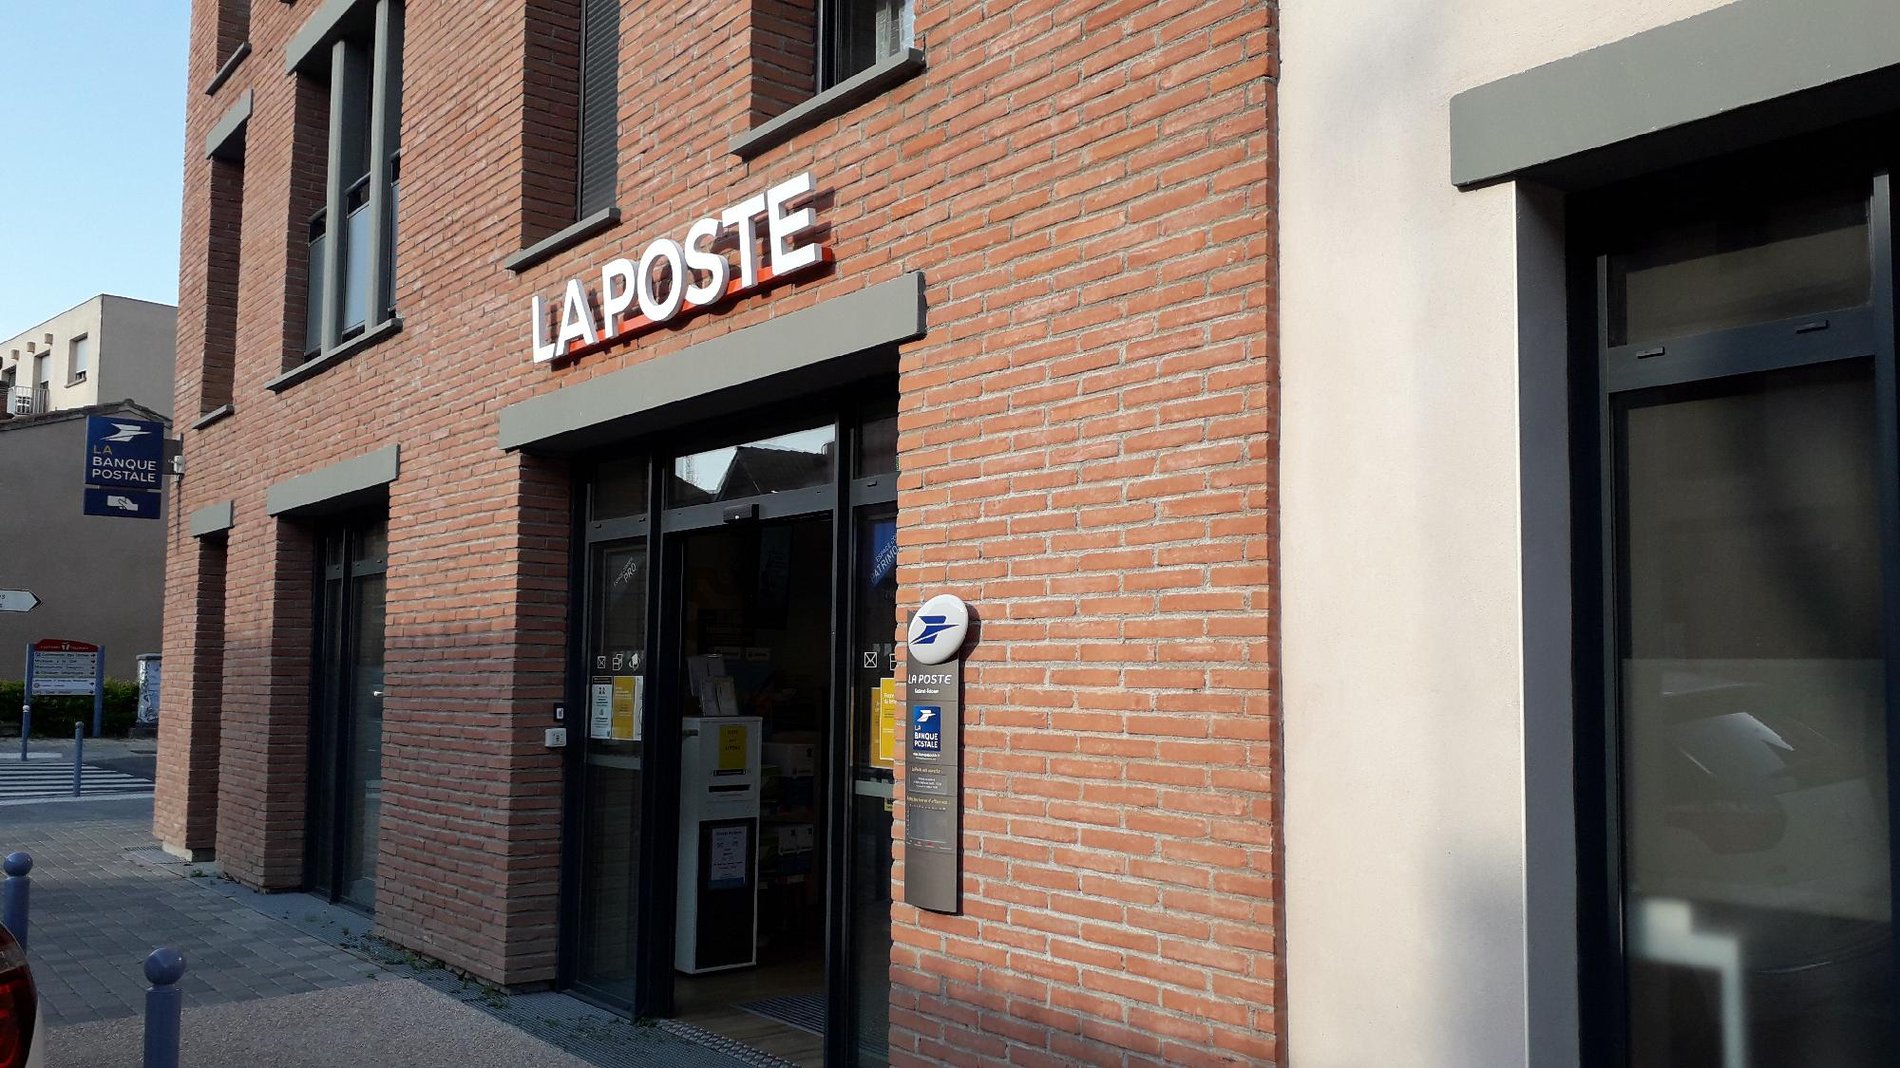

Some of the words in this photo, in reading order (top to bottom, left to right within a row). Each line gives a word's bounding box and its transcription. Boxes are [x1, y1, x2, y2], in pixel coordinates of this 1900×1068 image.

[531, 278, 599, 364] LA
[602, 172, 823, 339] POSTE
[93, 444, 113, 455] LA
[93, 457, 157, 471] BANQUE
[92, 468, 156, 483] POSTALE
[624, 562, 636, 582] PRO
[908, 674, 917, 685] LA
[918, 674, 953, 685] POSTE
[914, 732, 939, 741] BANQUE
[914, 740, 938, 749] POSTALE
